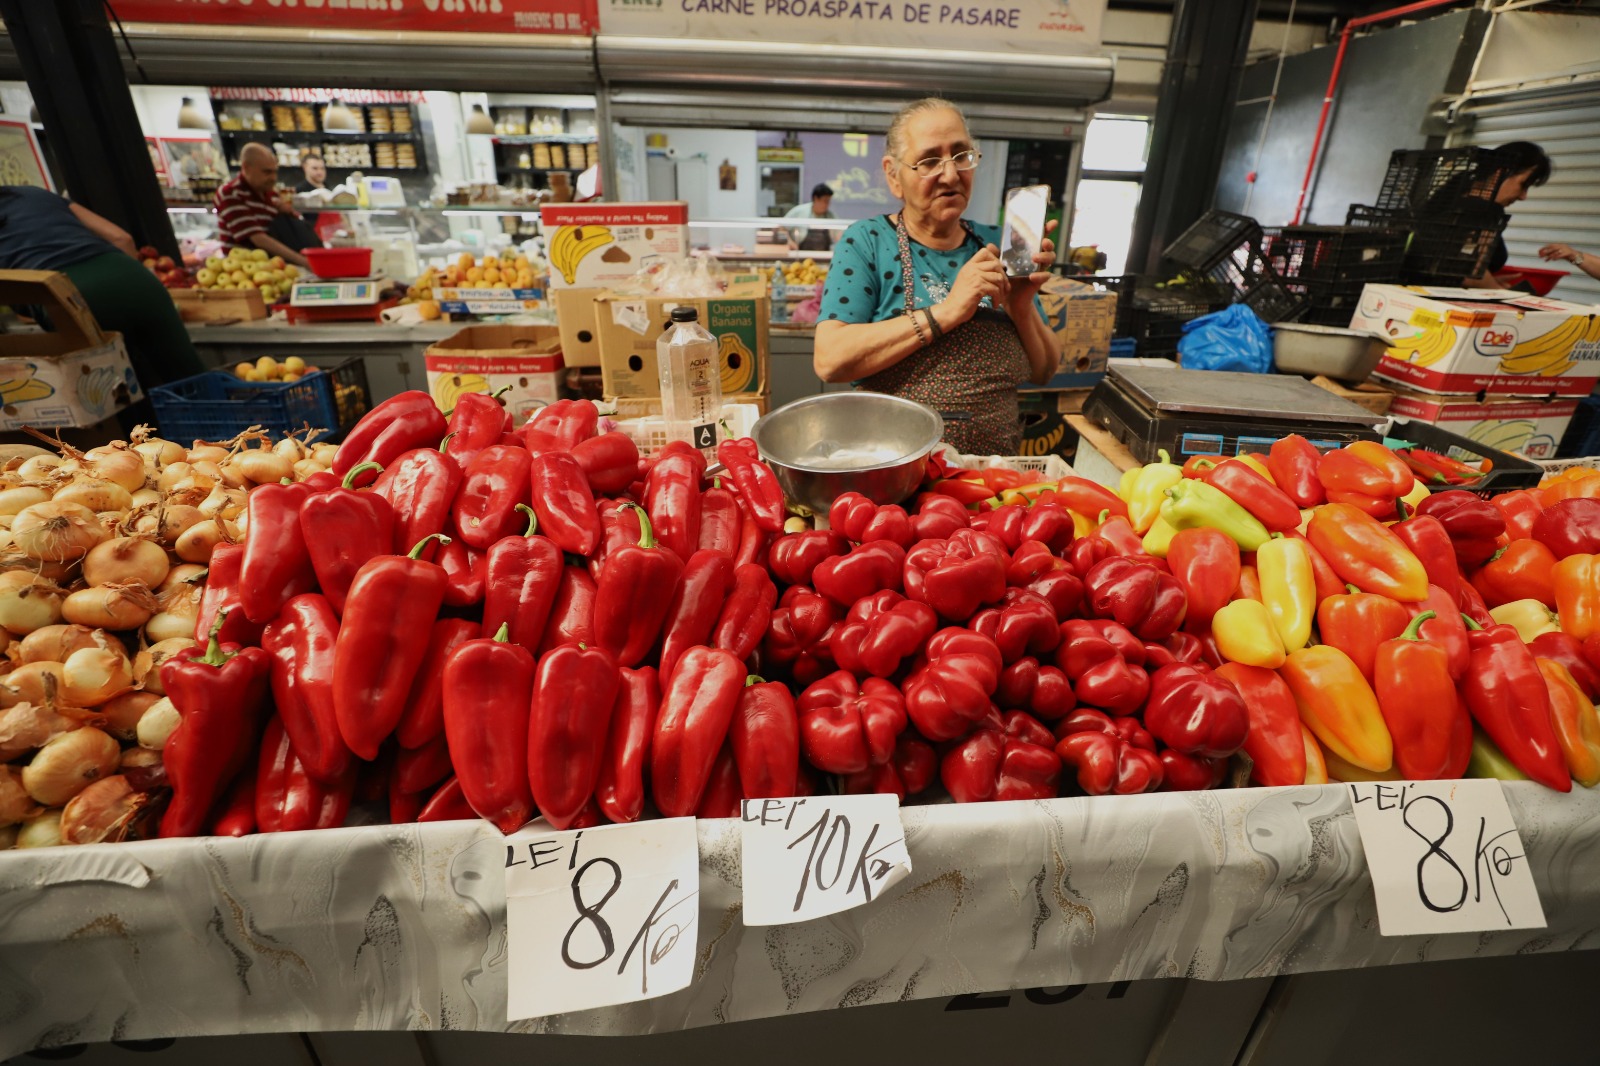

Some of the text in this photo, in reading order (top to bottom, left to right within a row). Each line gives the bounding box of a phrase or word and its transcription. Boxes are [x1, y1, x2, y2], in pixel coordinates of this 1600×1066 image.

[681, 0, 1021, 28] CARNE PROASPATA DE PASARE
[712, 304, 751, 316] Organic
[712, 316, 752, 327] Bananas
[1482, 330, 1514, 345] Dole
[690, 357, 709, 368] AQUA
[787, 808, 851, 912] 10
[1402, 795, 1469, 913] 8
[561, 857, 622, 970] 8
